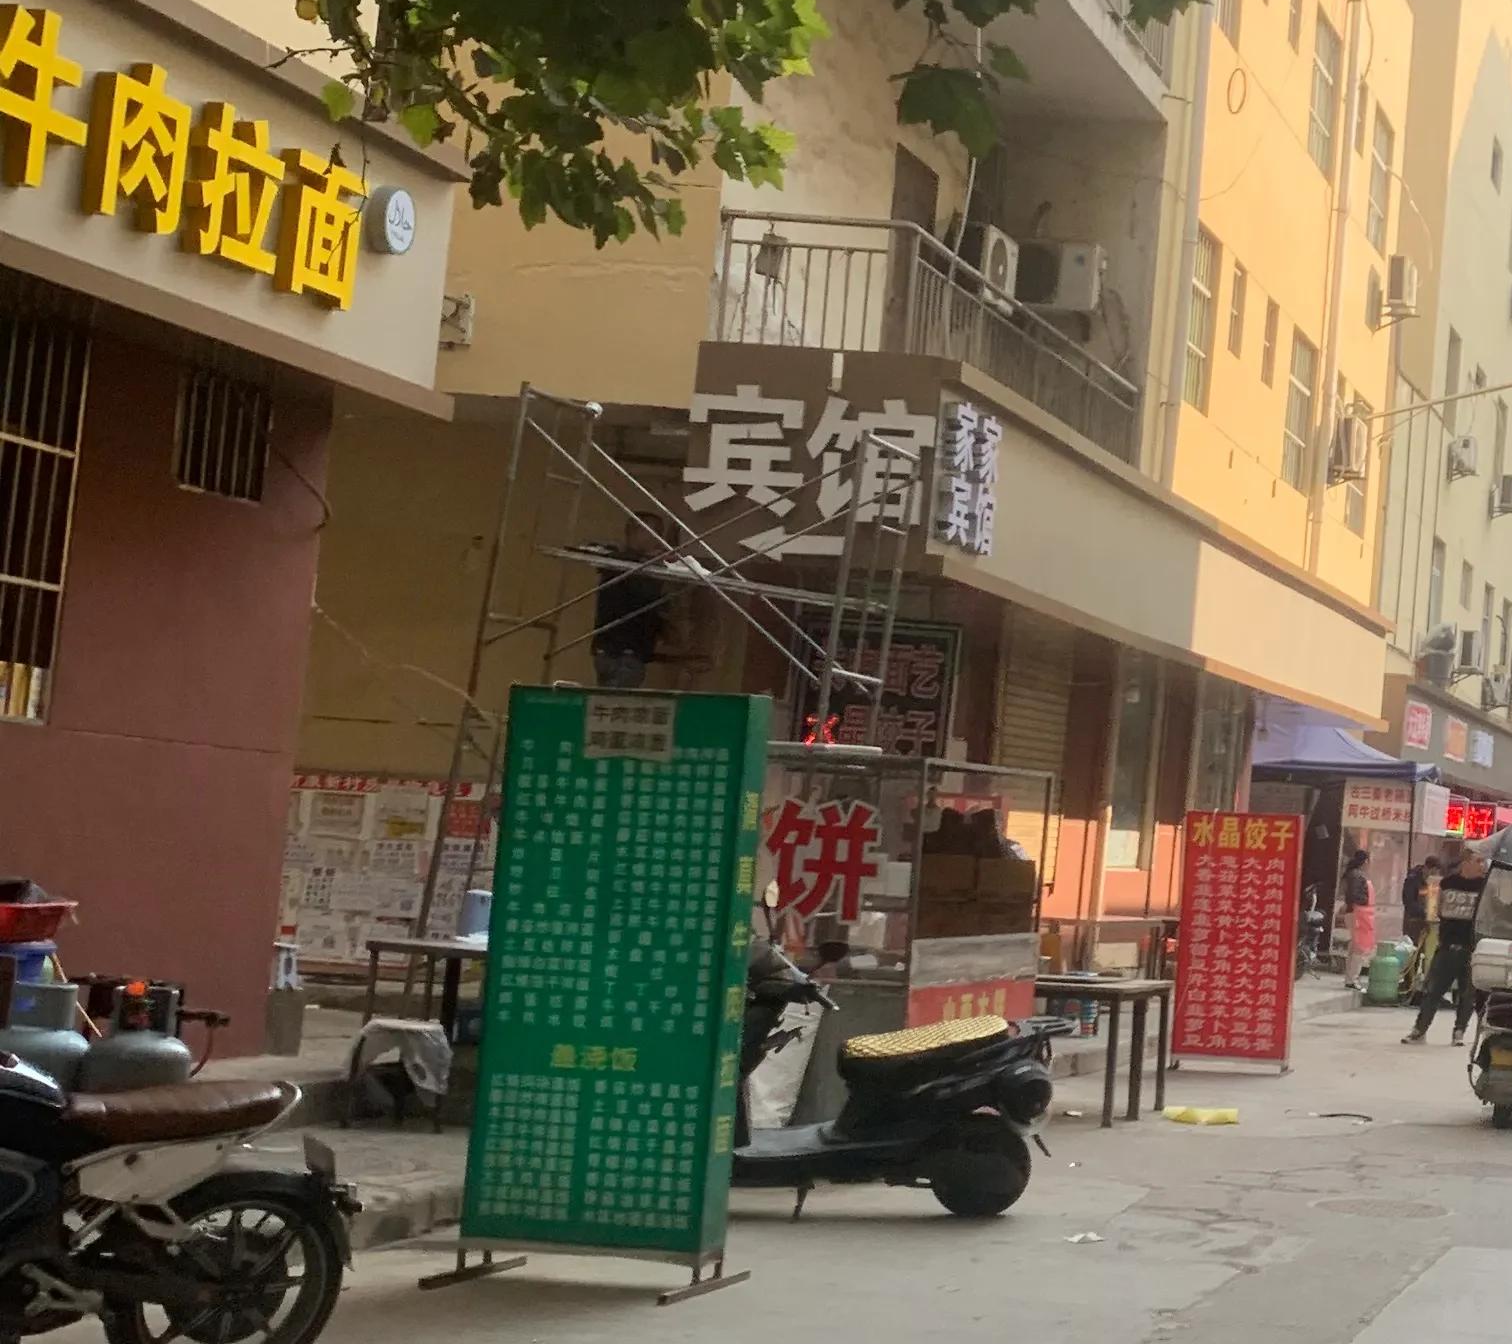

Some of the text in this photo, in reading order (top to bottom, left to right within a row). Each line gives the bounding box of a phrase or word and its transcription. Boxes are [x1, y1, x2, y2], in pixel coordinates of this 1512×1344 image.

[0, 3, 370, 312] 牛肉拉面
[682, 384, 937, 526] 宾馆
[766, 799, 879, 922] 饼
[1192, 815, 1295, 851] 水晶饺子
[1187, 988, 1276, 1006] 白菜大肉
